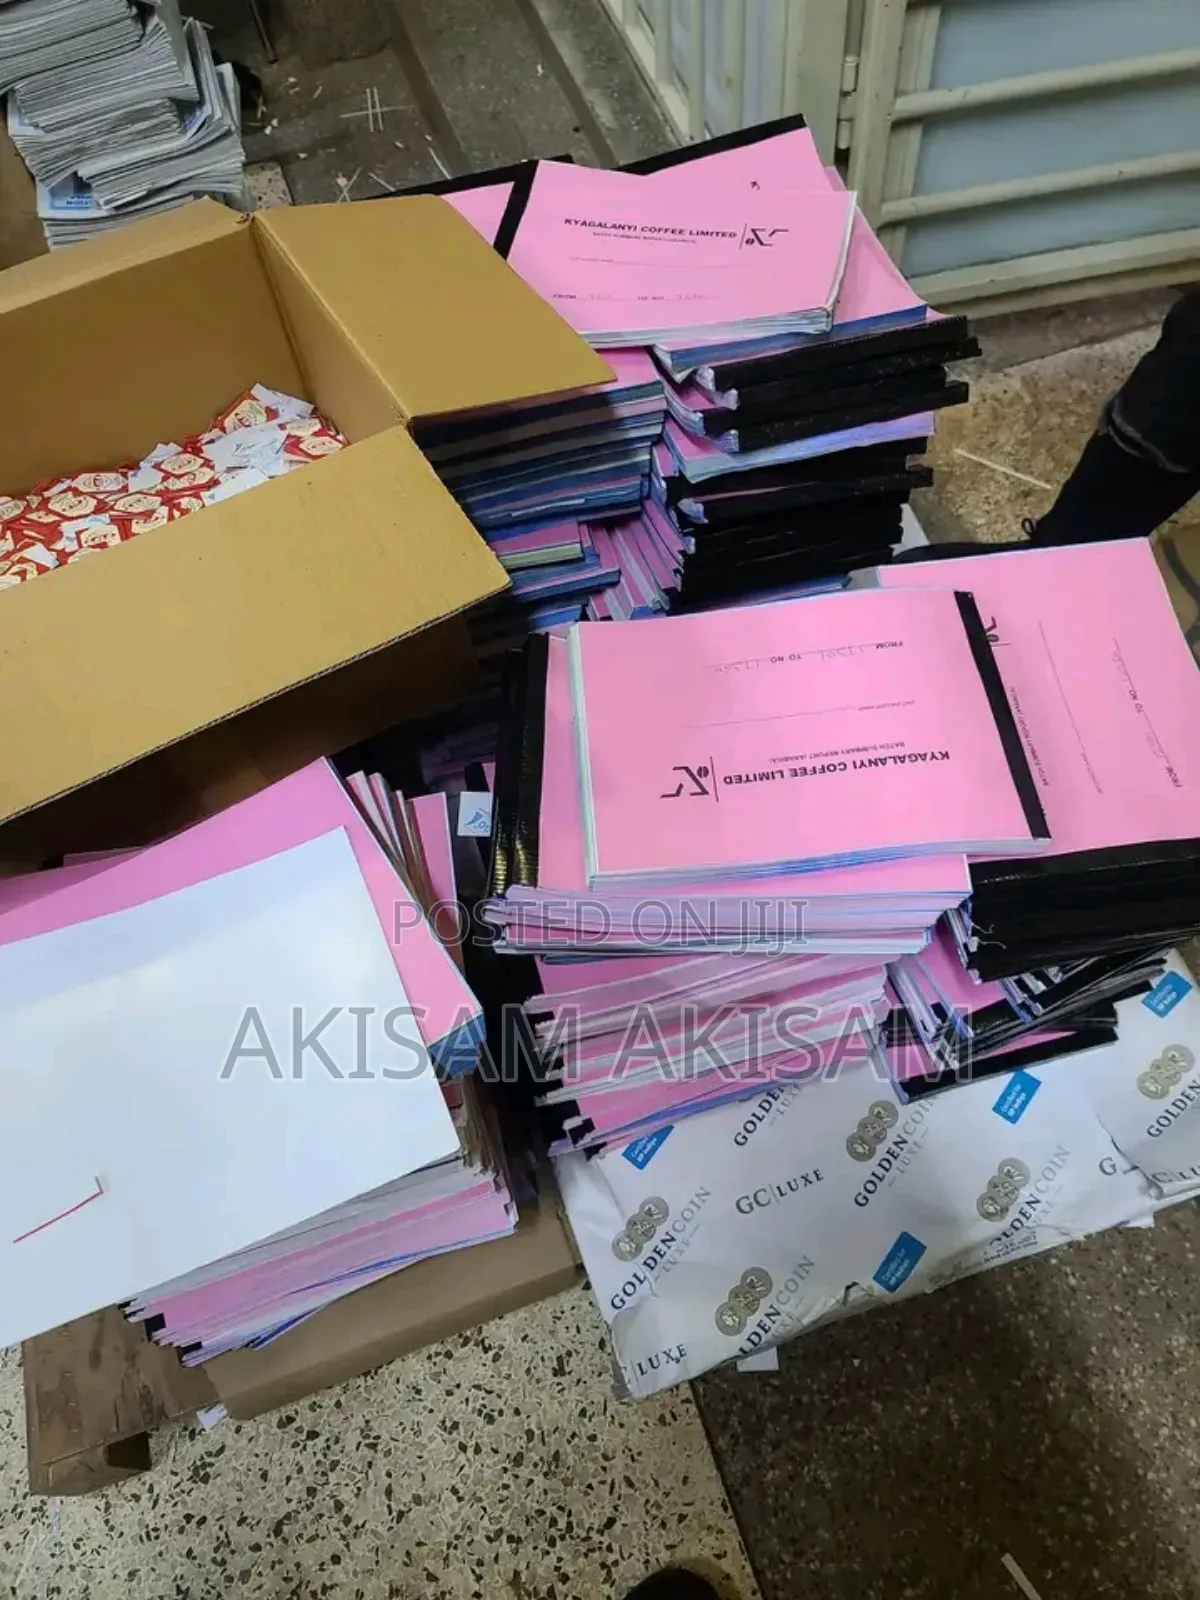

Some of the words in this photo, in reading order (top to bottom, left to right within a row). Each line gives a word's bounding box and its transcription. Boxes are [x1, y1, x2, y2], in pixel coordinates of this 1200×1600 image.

[564, 218, 637, 232] KYAGALANYI
[640, 226, 686, 236] COFFEE
[689, 230, 738, 239] LIMITED
[876, 640, 904, 650] FROM
[788, 653, 802, 661] TO
[853, 750, 951, 770] KYAGALANYI
[722, 770, 785, 785] LIMITED
[790, 761, 848, 778] COFFEE
[733, 1085, 784, 1146] GOLDE
